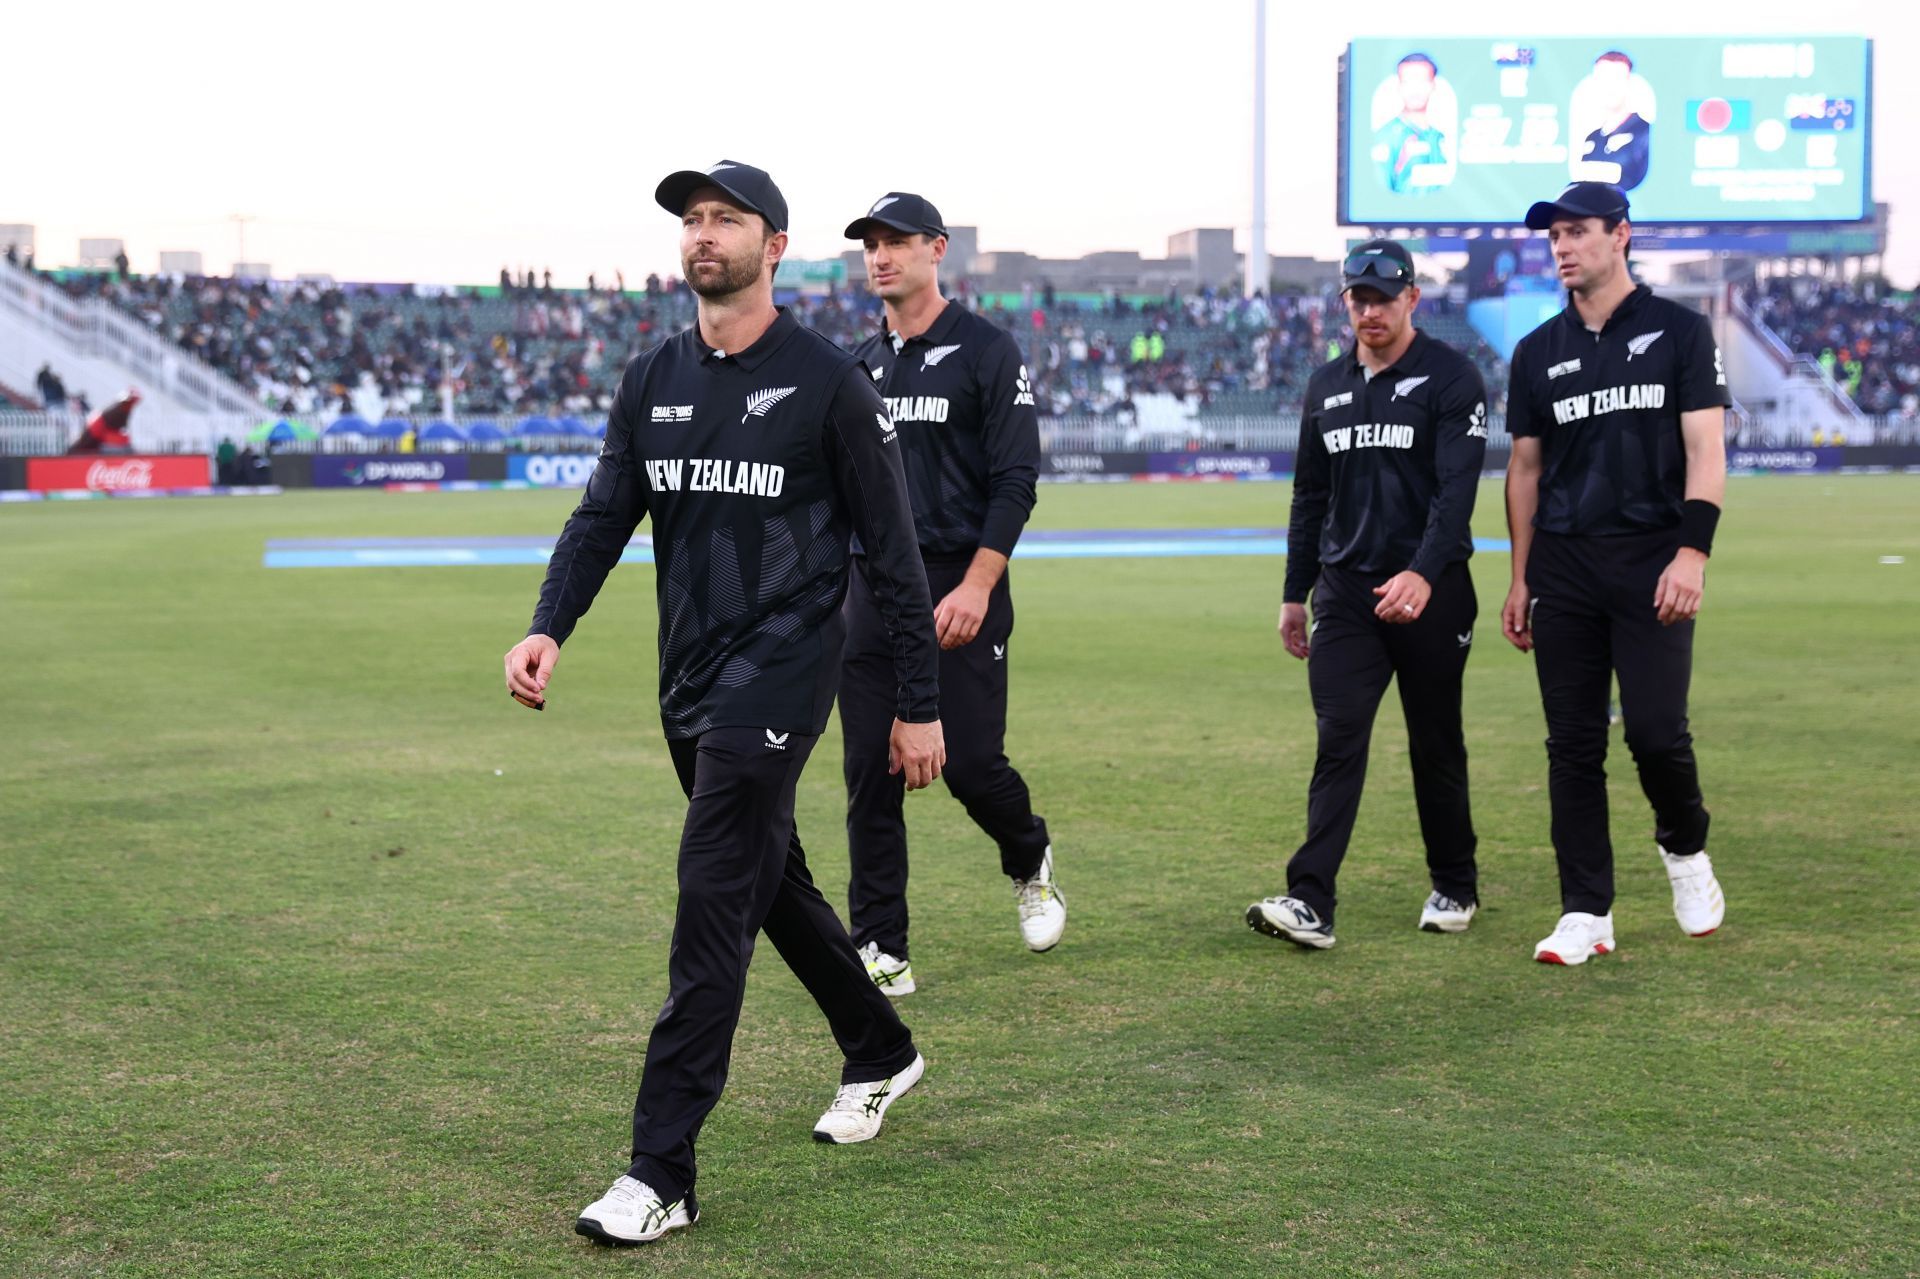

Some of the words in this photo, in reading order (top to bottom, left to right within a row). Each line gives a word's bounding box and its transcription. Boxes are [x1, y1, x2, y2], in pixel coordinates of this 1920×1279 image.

[883, 396, 949, 423] ZEALAND
[1552, 395, 1590, 425] NEW
[1592, 384, 1666, 416] ZEALAND
[1323, 427, 1352, 455] NEW
[1355, 423, 1414, 449] ZELAND
[390, 461, 445, 480] WORLD
[1219, 457, 1270, 473] WORLD
[1760, 452, 1817, 469] WORLD
[645, 460, 683, 491] NEW
[689, 459, 785, 497] ZEALAND
